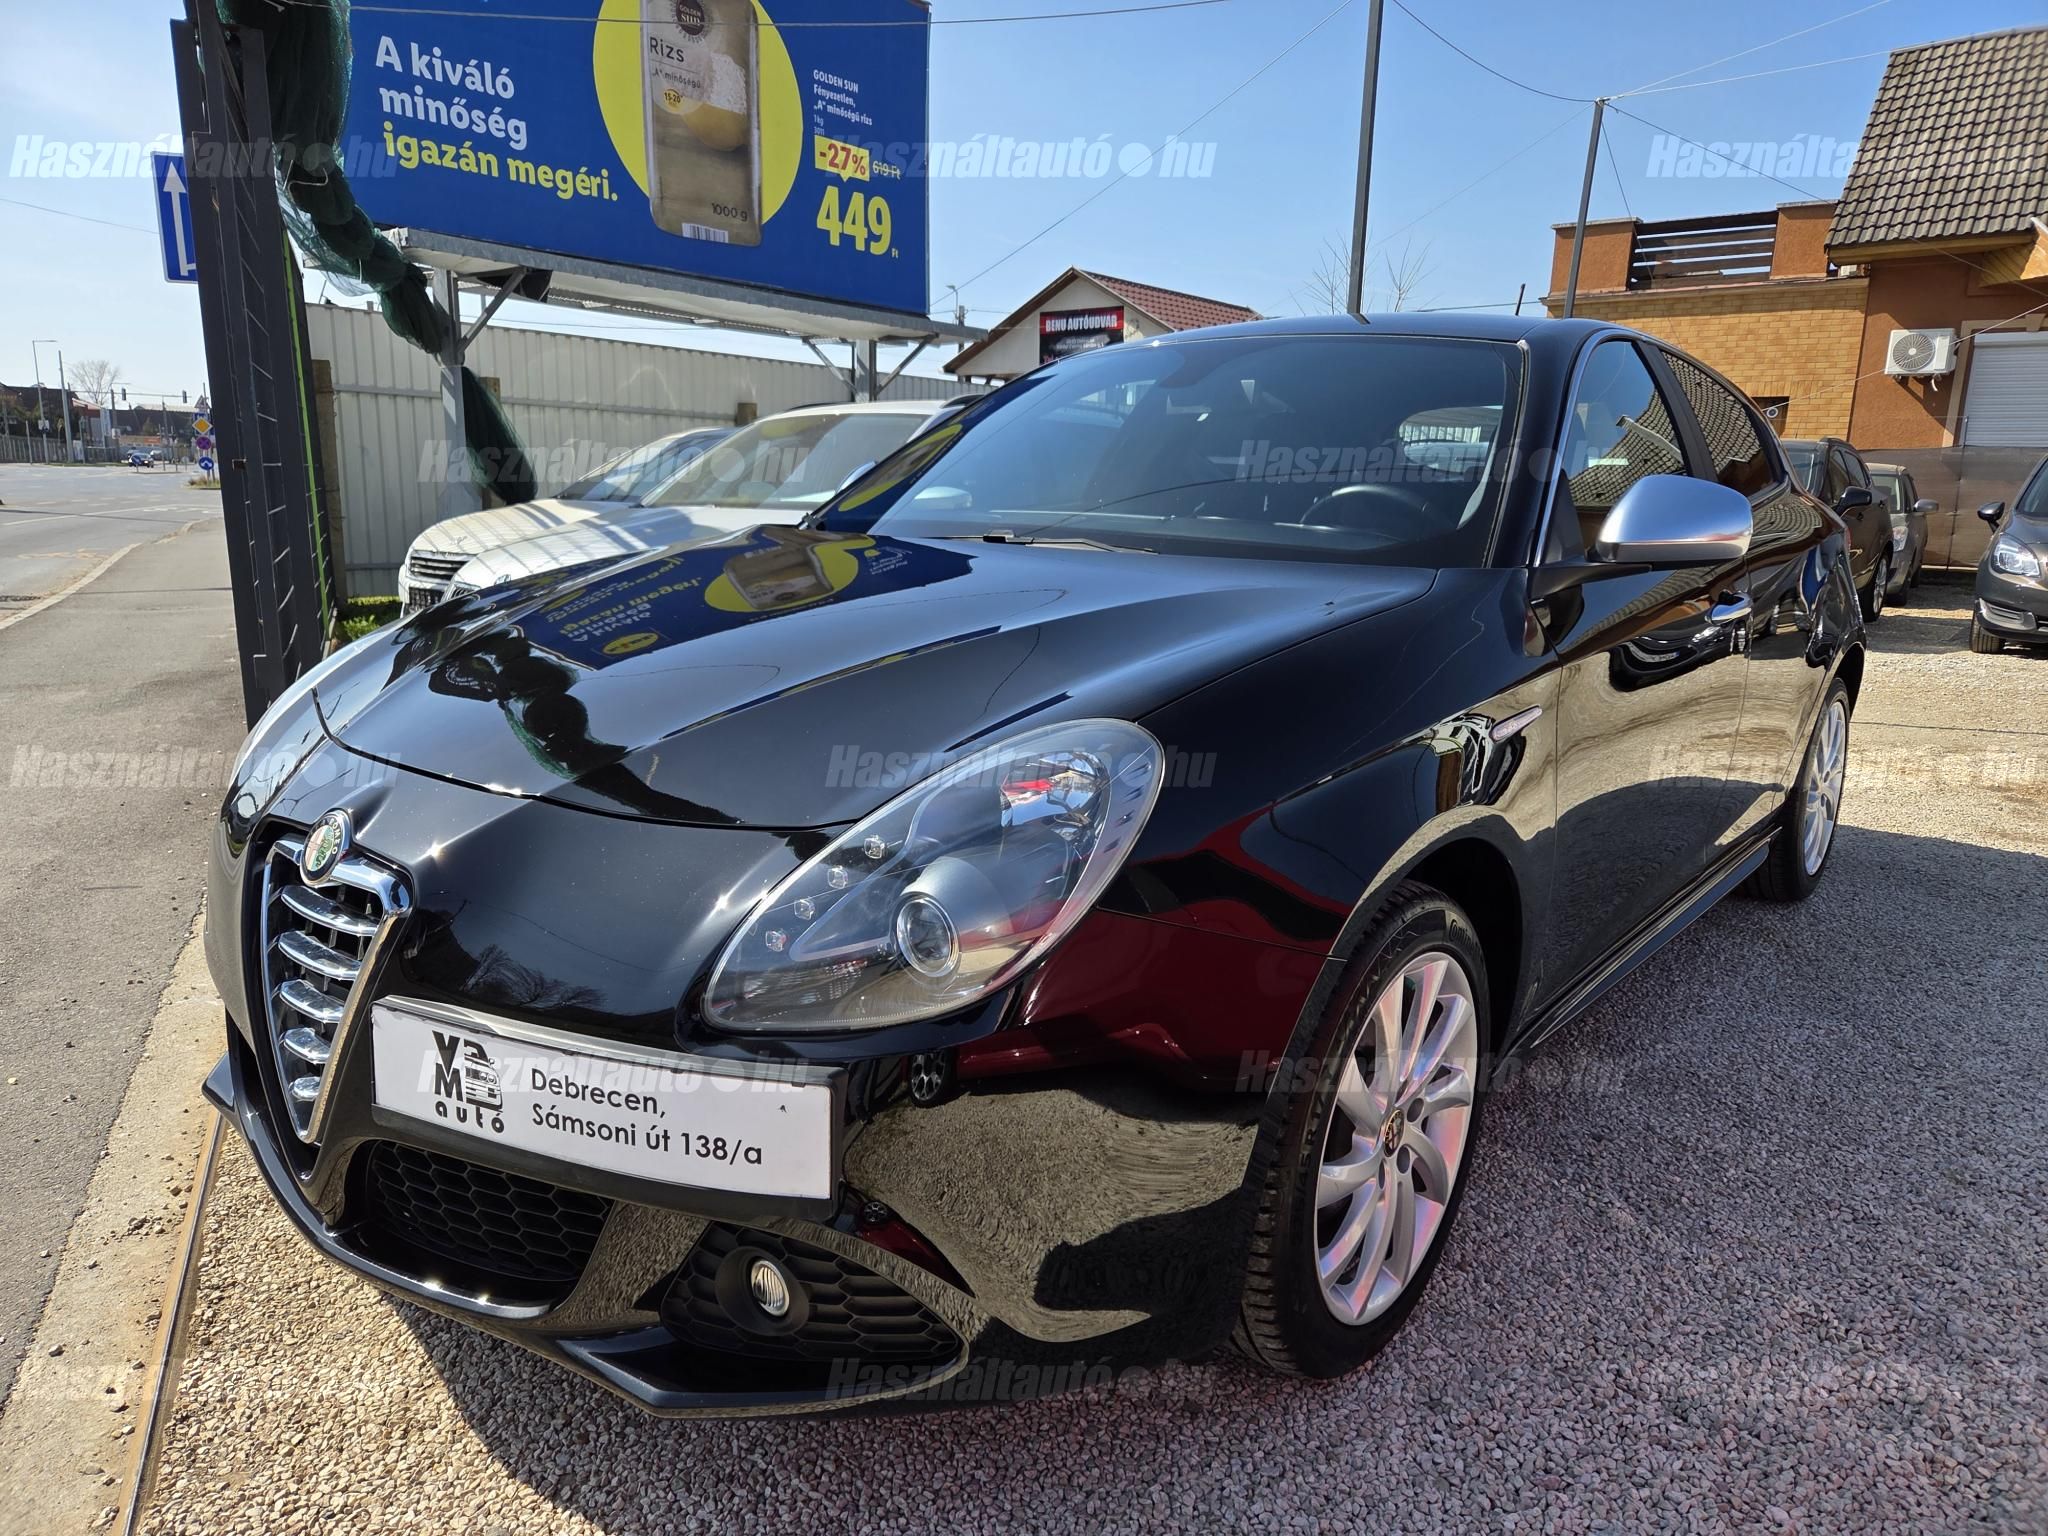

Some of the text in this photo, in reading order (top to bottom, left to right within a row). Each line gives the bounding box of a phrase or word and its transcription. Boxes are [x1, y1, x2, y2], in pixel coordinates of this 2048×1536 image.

[649, 36, 684, 62] Rizs
[375, 35, 515, 99] A kiváló
[813, 69, 859, 94] GOLDEN SUN
[813, 84, 856, 108] Fényezetlen,
[379, 84, 528, 151] minőség
[826, 104, 860, 123] minőségű
[860, 113, 873, 126] rizs
[383, 120, 618, 202] igazán megéri.
[819, 142, 866, 176] -27%
[872, 160, 901, 180] 619 Ft
[711, 202, 748, 222] 1000 g
[816, 185, 892, 255] 449
[891, 247, 899, 258] Ft
[1067, 314, 1118, 331] AUTÓUDVAR
[531, 1068, 667, 1119] Debrecen,
[434, 1101, 505, 1134] autó
[532, 1104, 763, 1165] Sámsoni út 138/a
